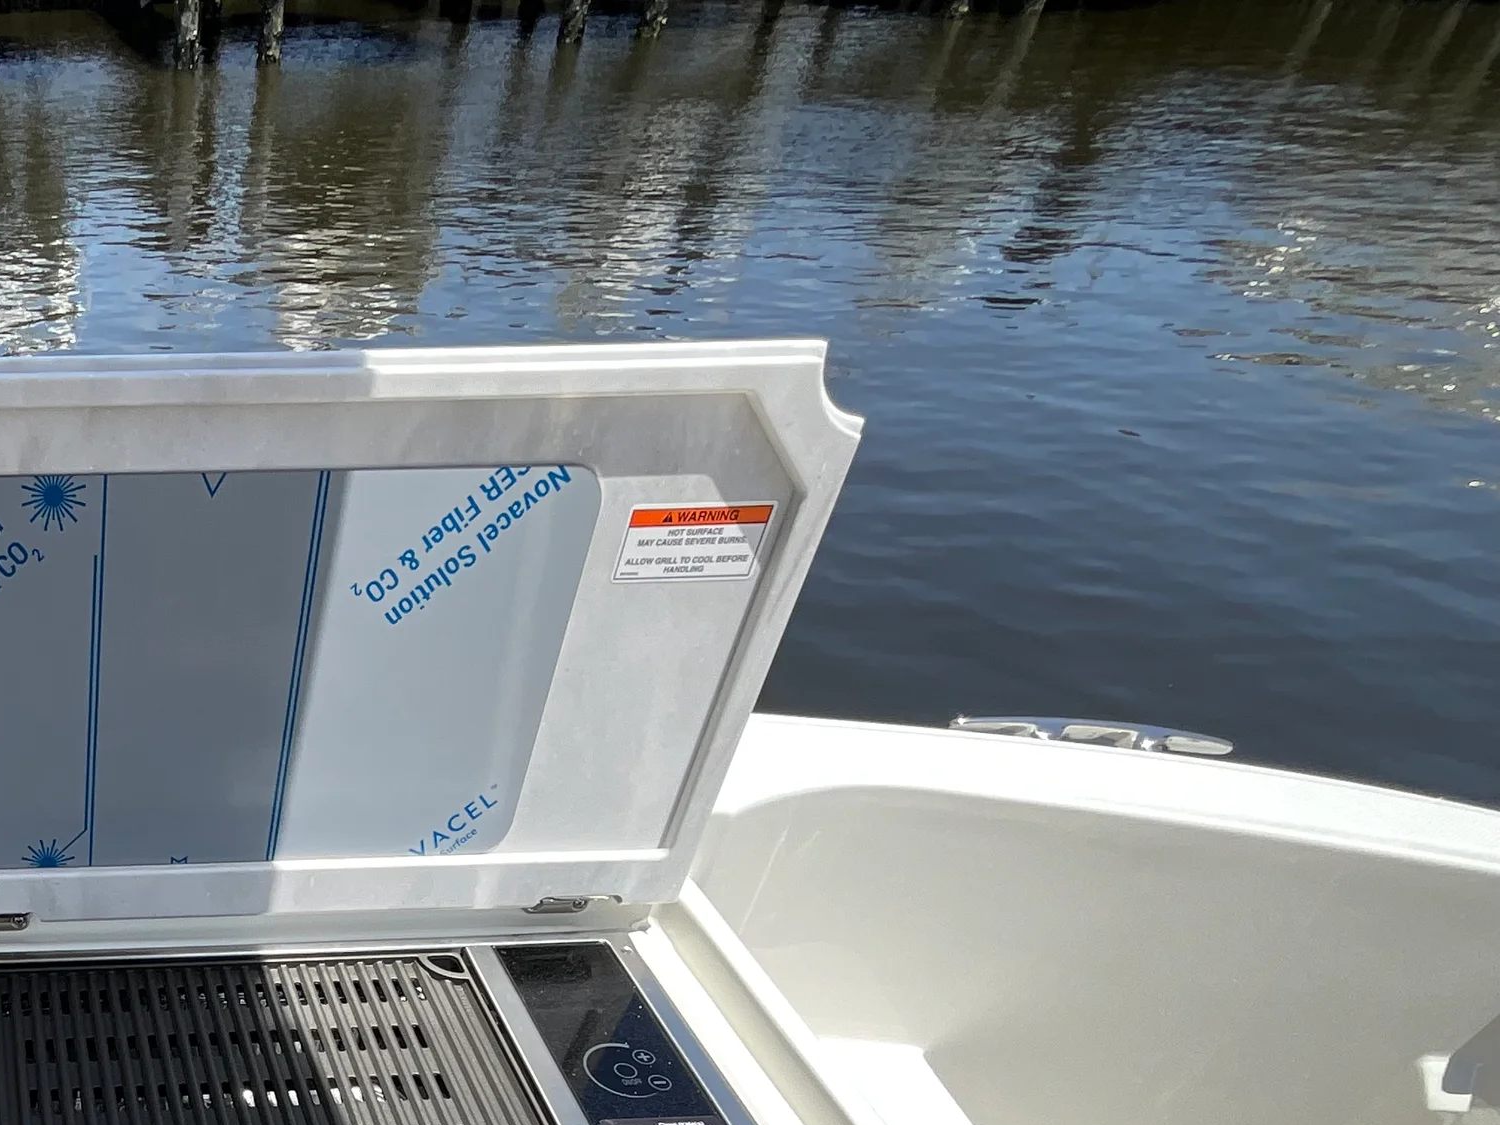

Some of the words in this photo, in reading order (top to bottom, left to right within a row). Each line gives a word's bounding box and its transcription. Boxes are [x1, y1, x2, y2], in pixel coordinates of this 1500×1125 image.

[476, 465, 572, 553] Novacel
[677, 510, 741, 522] WARNING
[421, 495, 482, 553] Fiber
[667, 528, 685, 537] HOT
[686, 527, 724, 536] SURFACE
[637, 539, 653, 548] MAY
[655, 538, 683, 547] CAUSE
[684, 537, 716, 545] SEVERE
[397, 549, 420, 570] &
[625, 557, 654, 566] ALLOW
[655, 556, 678, 565] GRILL
[680, 555, 690, 564] TO
[691, 555, 714, 564] COOL
[716, 554, 749, 563] BEFORE
[662, 565, 704, 574] HANDLING
[384, 545, 477, 625] Solution
